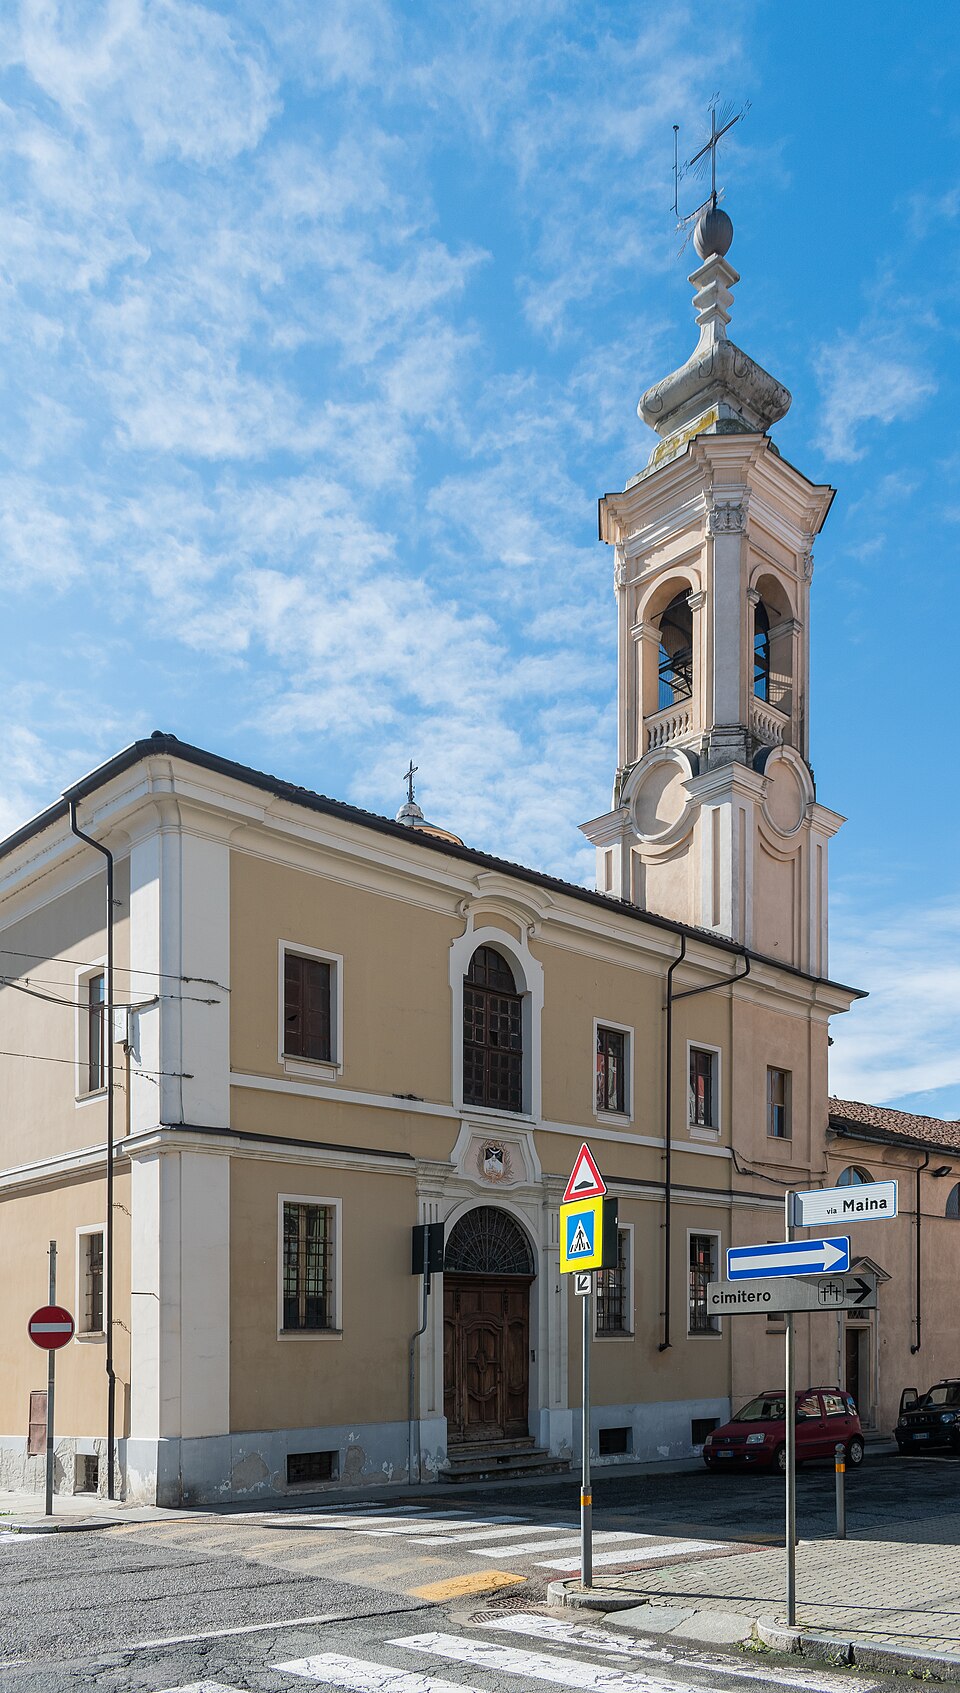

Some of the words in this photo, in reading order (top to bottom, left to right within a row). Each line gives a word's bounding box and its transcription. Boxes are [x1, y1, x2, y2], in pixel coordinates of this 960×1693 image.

[826, 1207, 837, 1215] via
[842, 1198, 888, 1212] Maina
[712, 1290, 771, 1304] cimitero
